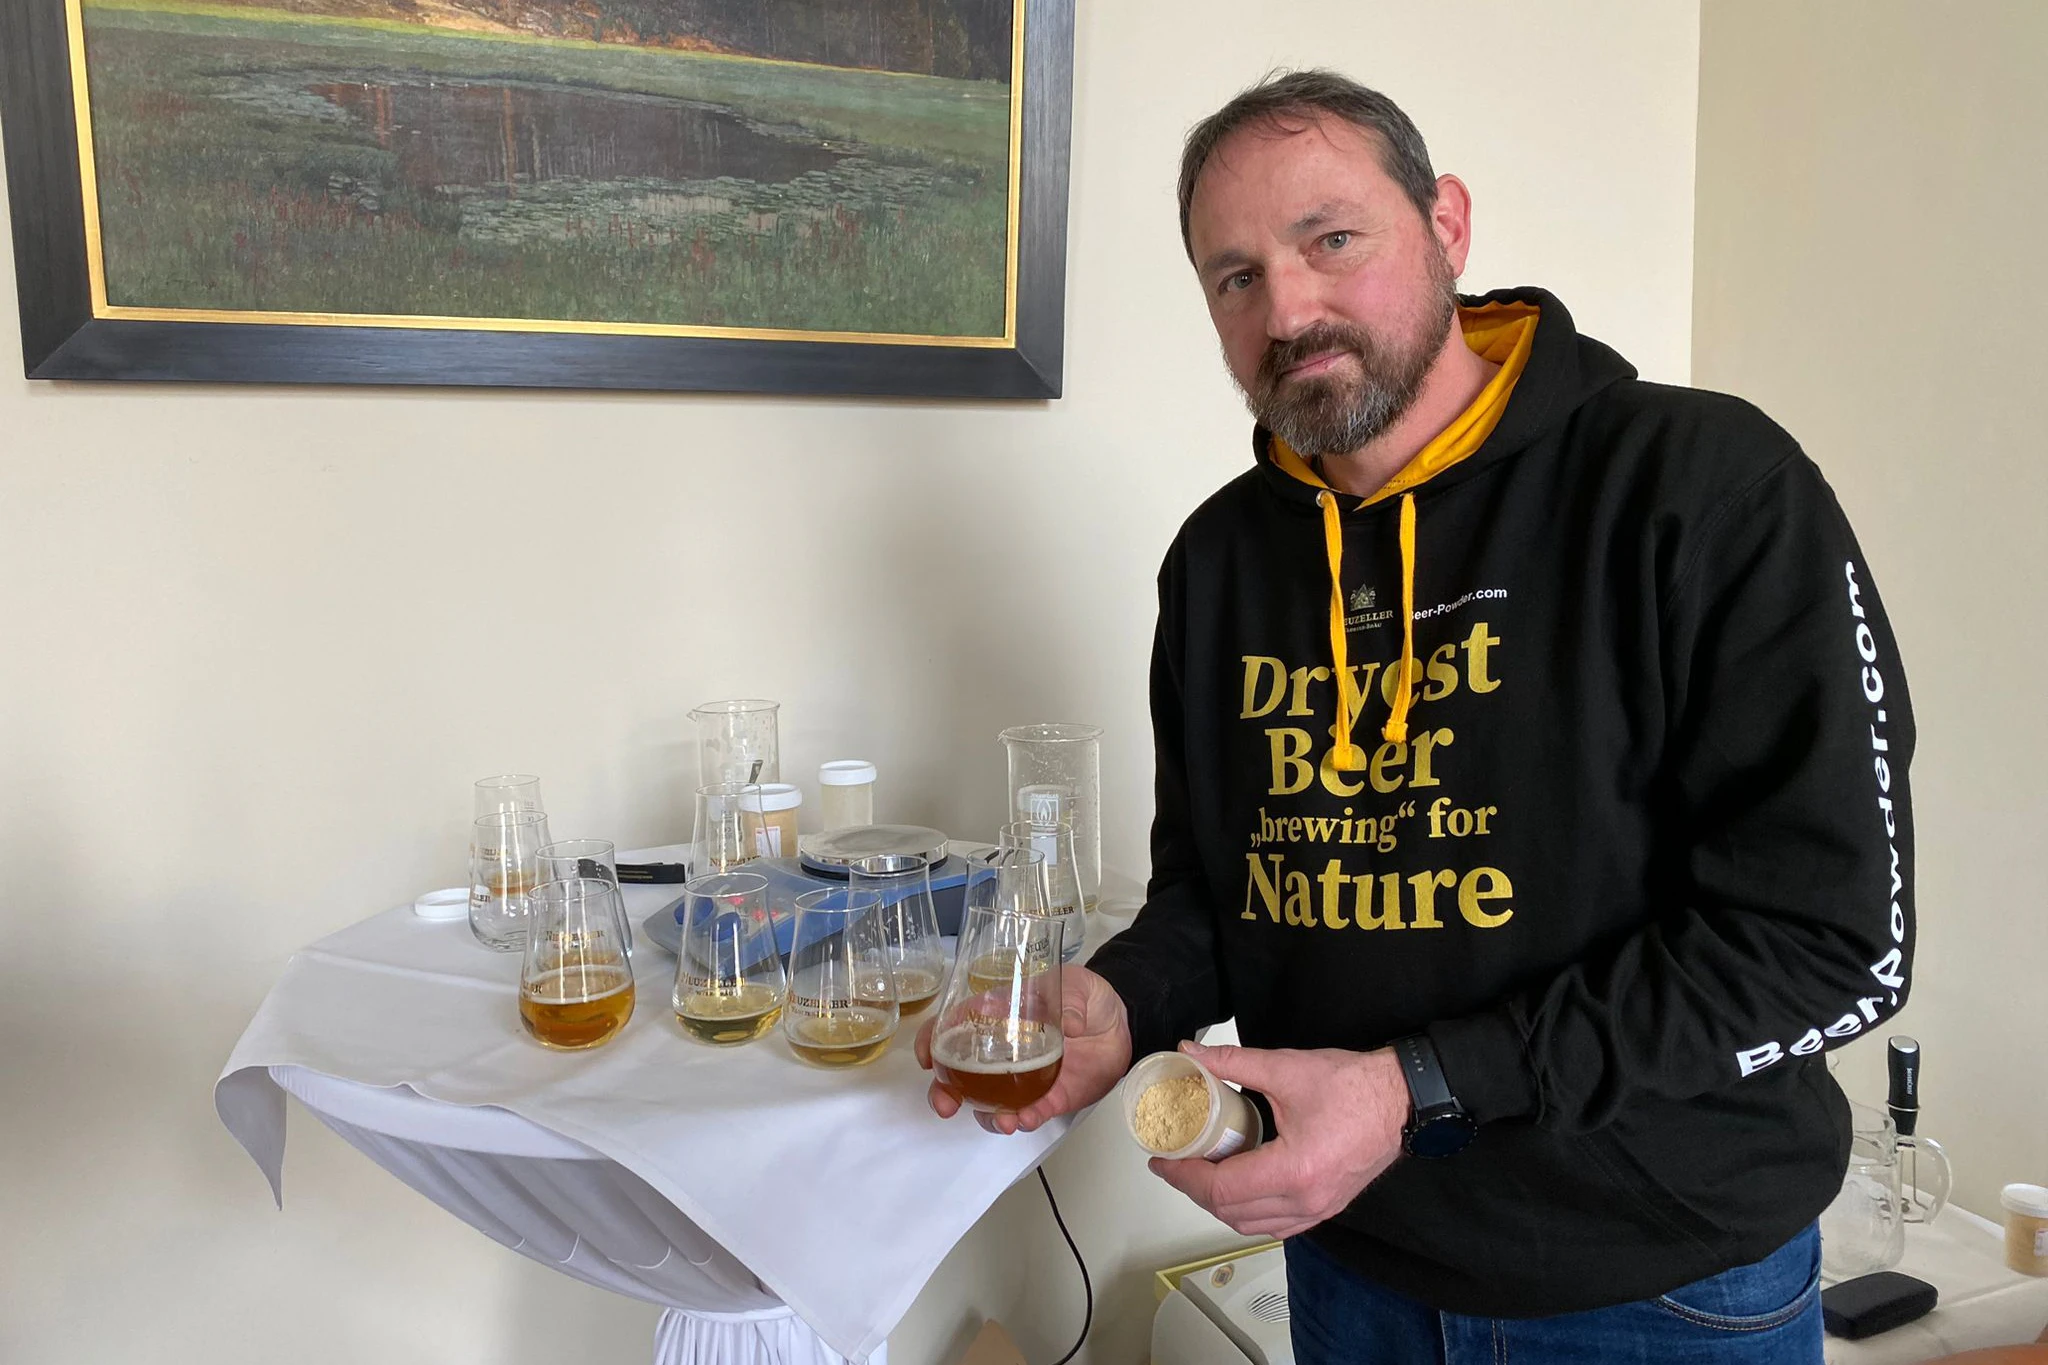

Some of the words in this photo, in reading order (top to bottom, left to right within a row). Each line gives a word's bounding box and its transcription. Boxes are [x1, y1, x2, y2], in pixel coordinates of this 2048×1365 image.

[1344, 609, 1394, 626] EUZELLER
[1240, 621, 1502, 736] Dryest
[1264, 727, 1455, 798] Beer
[1427, 797, 1498, 838] for
[1240, 852, 1515, 931] Nature
